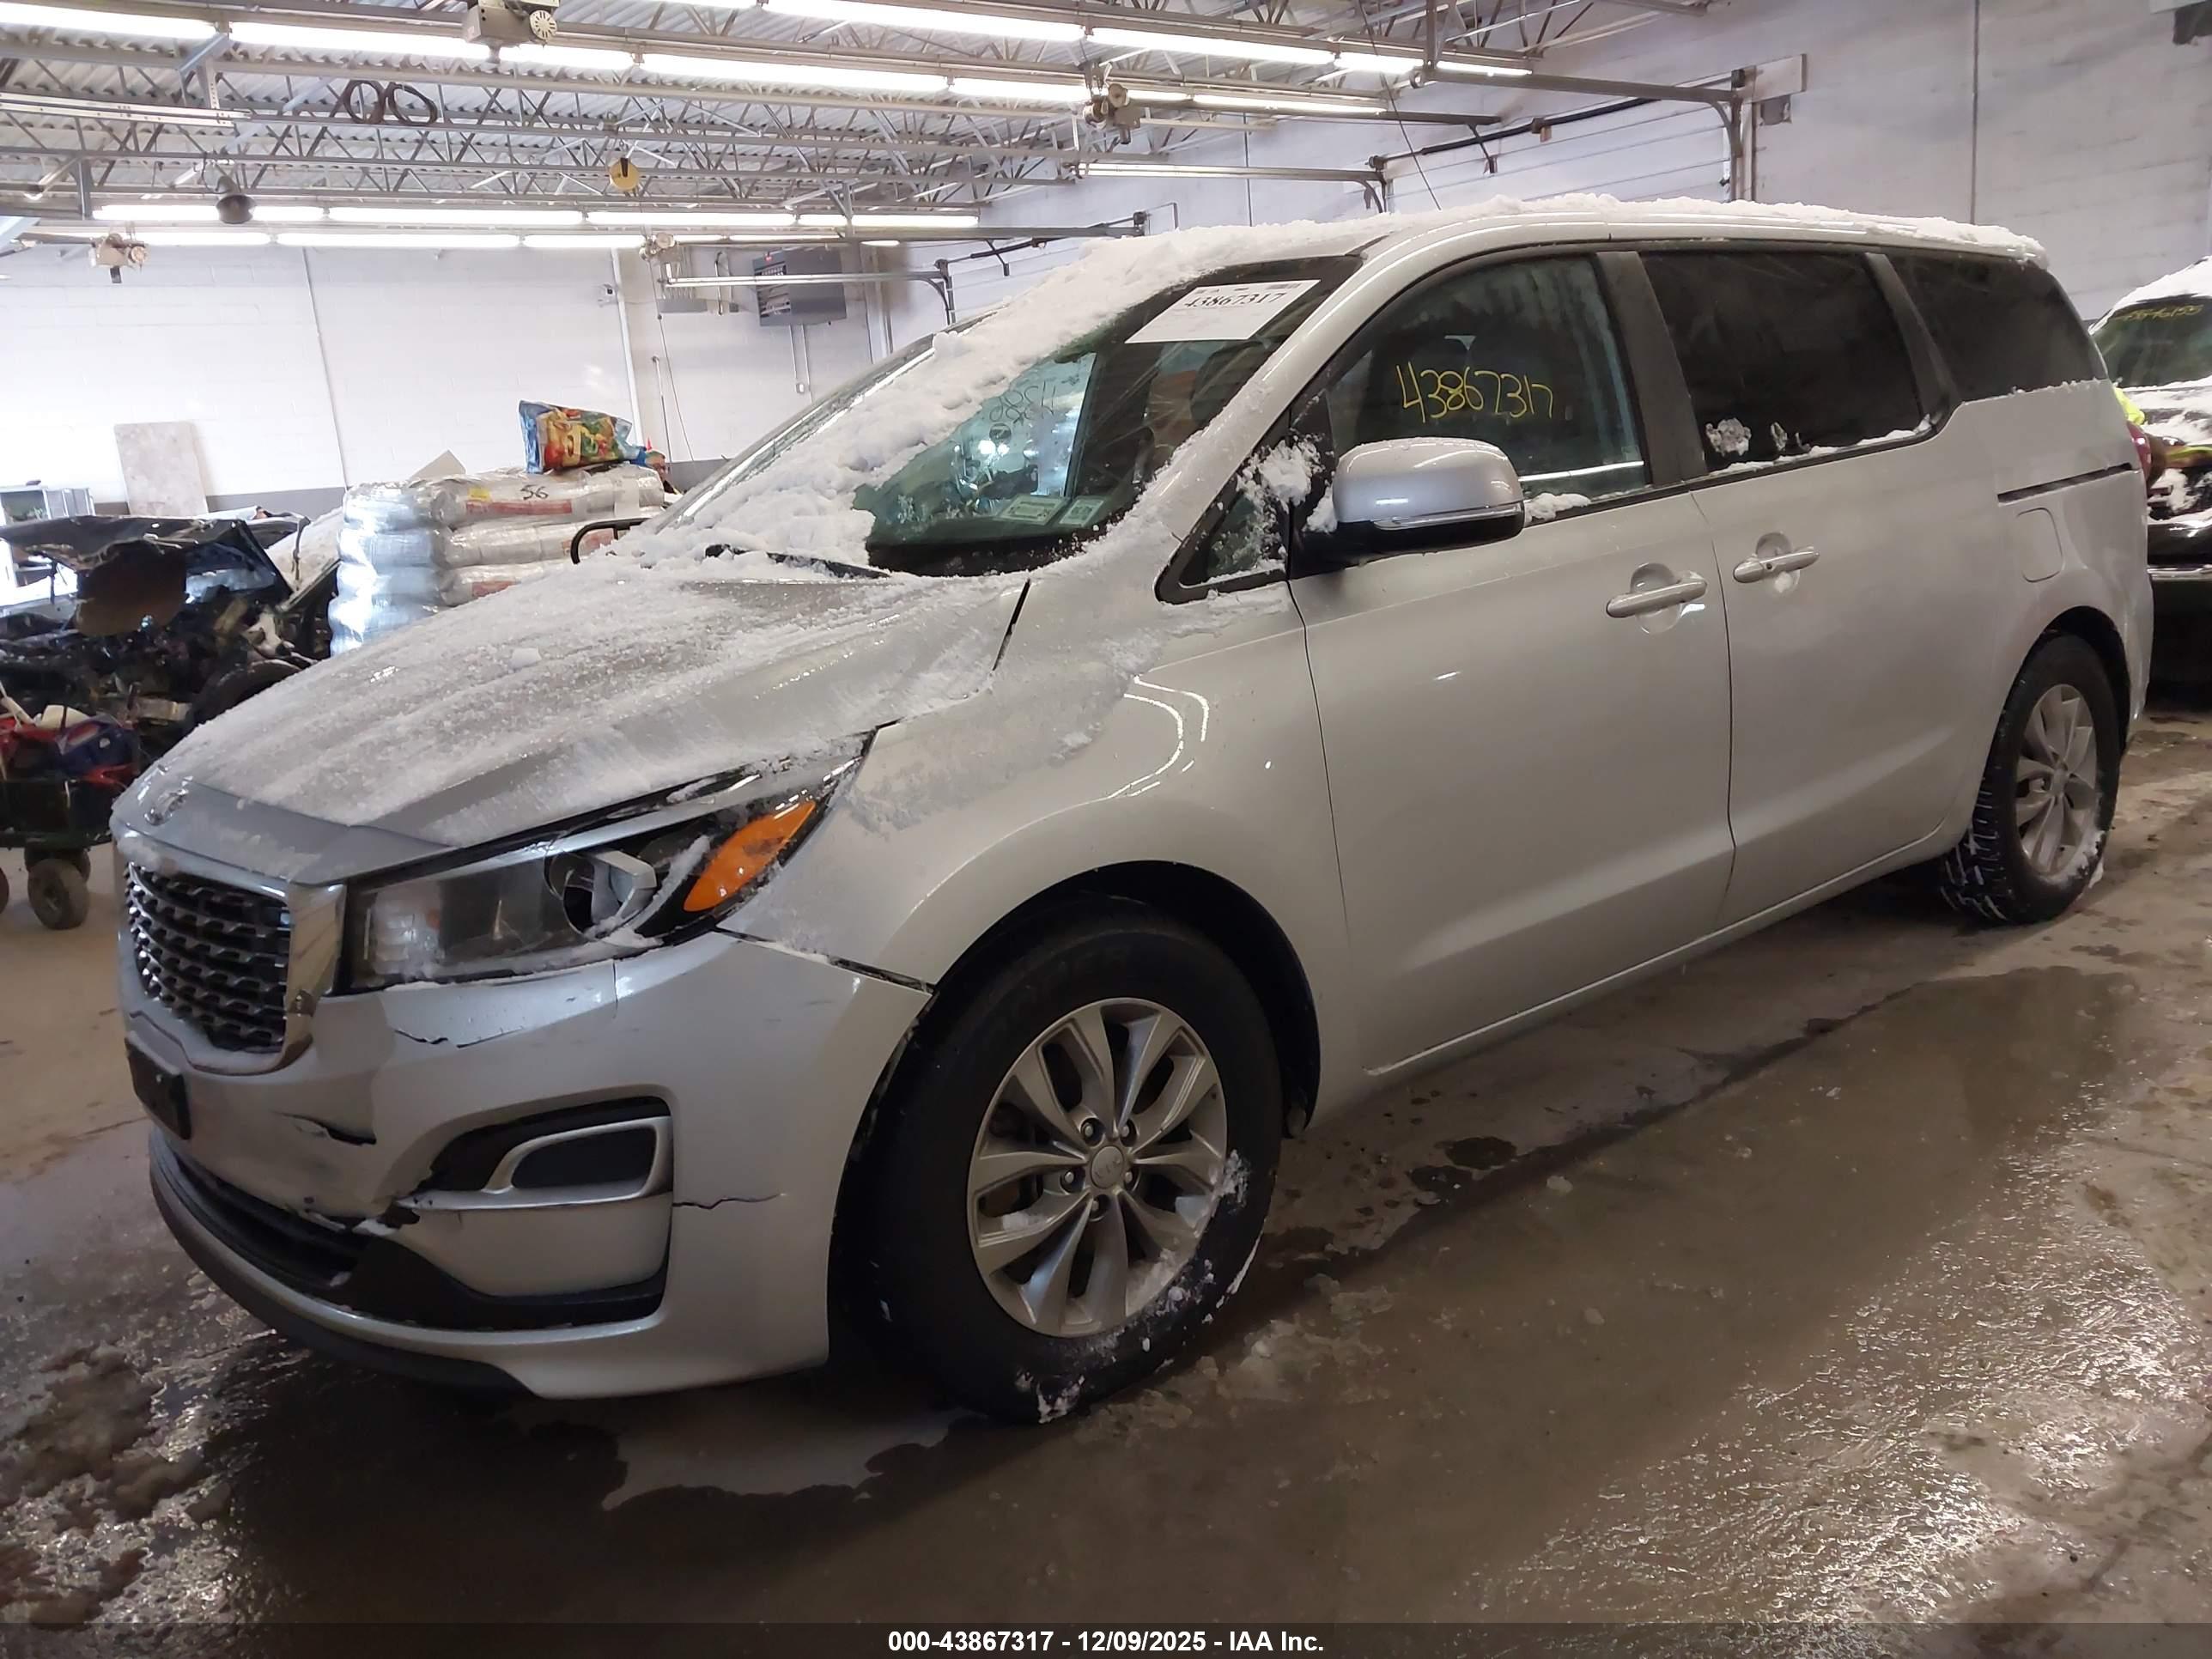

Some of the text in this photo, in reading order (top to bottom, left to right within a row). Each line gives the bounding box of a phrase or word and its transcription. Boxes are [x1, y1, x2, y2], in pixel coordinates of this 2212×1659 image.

[1186, 292, 1286, 307] 43867317
[1395, 361, 1553, 423] 43867317
[520, 484, 549, 500] 56
